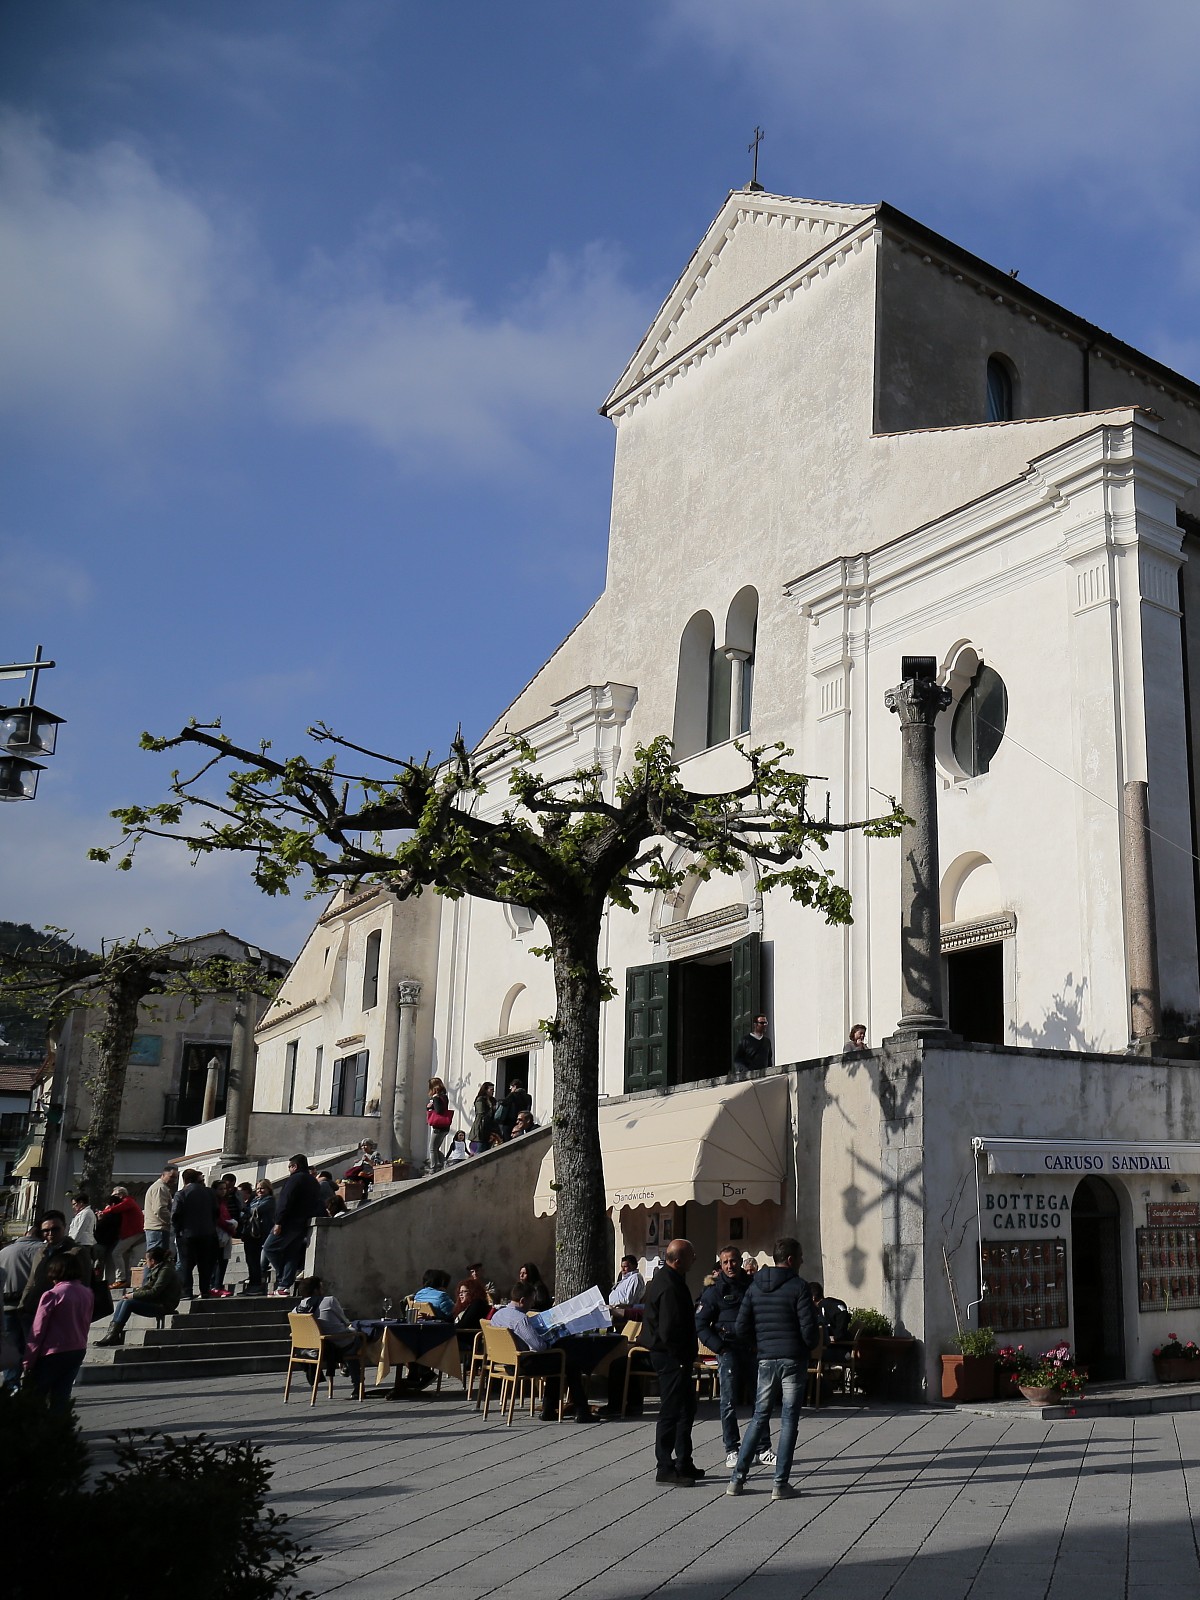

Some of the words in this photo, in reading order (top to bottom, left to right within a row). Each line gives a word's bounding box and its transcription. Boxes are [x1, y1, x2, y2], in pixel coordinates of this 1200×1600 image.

[1044, 1155, 1104, 1170] CARUSO
[1112, 1156, 1171, 1170] SANDALI
[613, 1187, 655, 1205] Sandwiches
[722, 1182, 747, 1197] Bar
[985, 1193, 1070, 1210] BOTTEGA
[993, 1213, 1061, 1229] CARUSO
